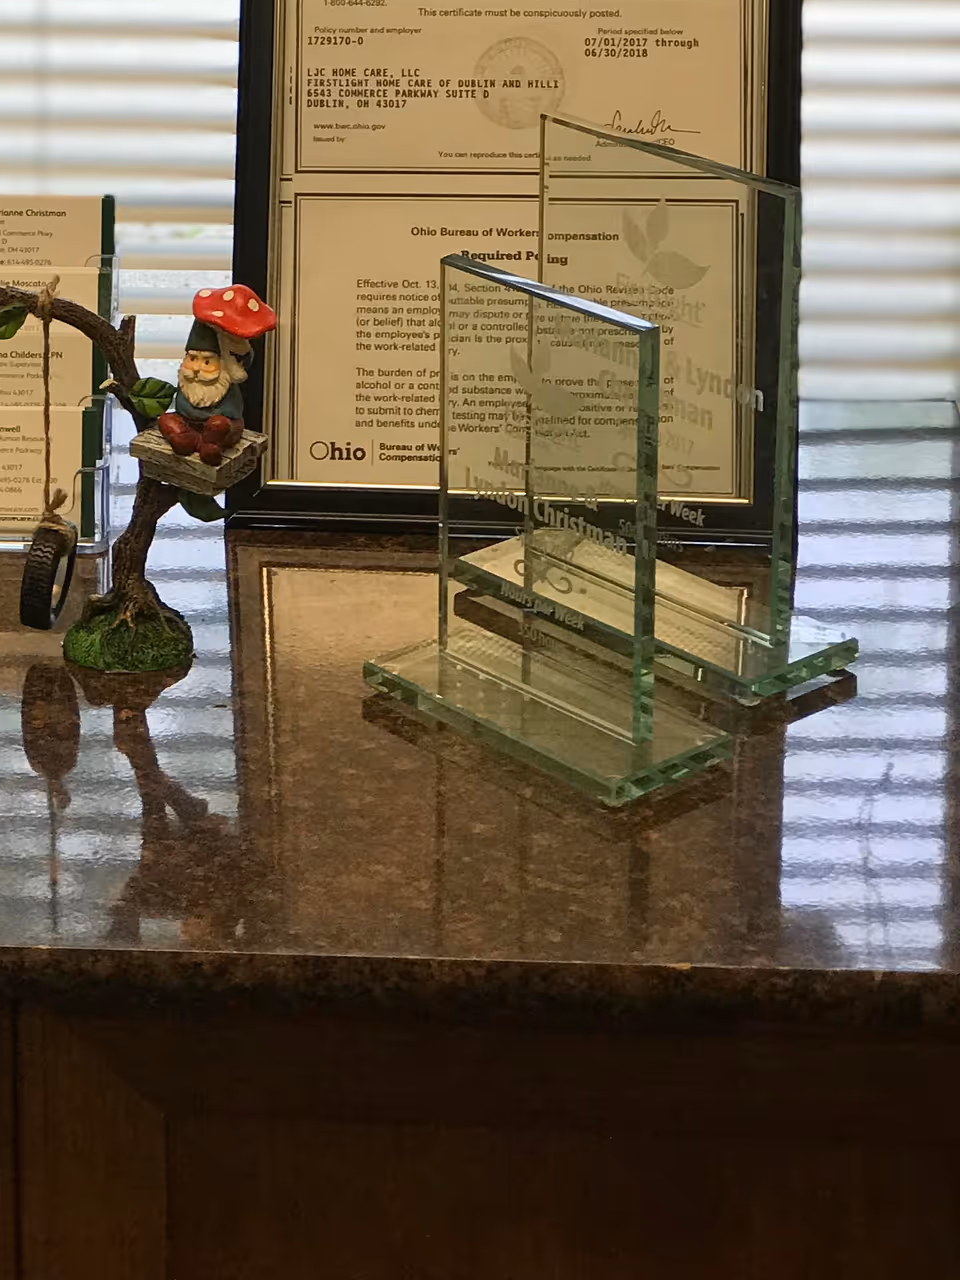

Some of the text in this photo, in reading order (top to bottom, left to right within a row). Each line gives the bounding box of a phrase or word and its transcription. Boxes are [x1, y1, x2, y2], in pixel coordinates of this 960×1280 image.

[418, 8, 622, 19] This certificate must be conspicuously posted.
[624, 28, 658, 36] specified
[308, 36, 364, 45] 1729170-0
[584, 37, 699, 50] 07/01/2017 through
[584, 48, 648, 58] 06/30/2018
[307, 68, 420, 78] LJC HOME CARE, LLC
[307, 78, 558, 90] FIRSTLIGHT HOME CARE OF DUBLIN AND HILLI
[306, 89, 489, 100] 6543 COMMERCE PARKWAY SUITE D
[306, 99, 407, 110] DUBLIN, OH 43017
[25, 209, 66, 217] Christman
[411, 226, 620, 243] Ohio Bureau of Workers ompensation
[461, 250, 522, 262] Required
[12, 279, 47, 287] Moscato
[356, 278, 398, 288] Effective
[402, 280, 421, 288] Oct.
[356, 342, 436, 352] the work-related
[10, 350, 42, 359] Childers
[356, 367, 428, 378] The burden of
[309, 440, 366, 461] Ohio
[379, 442, 426, 452] Bureau of
[670, 500, 705, 527] Week
[534, 500, 627, 556] Christman
